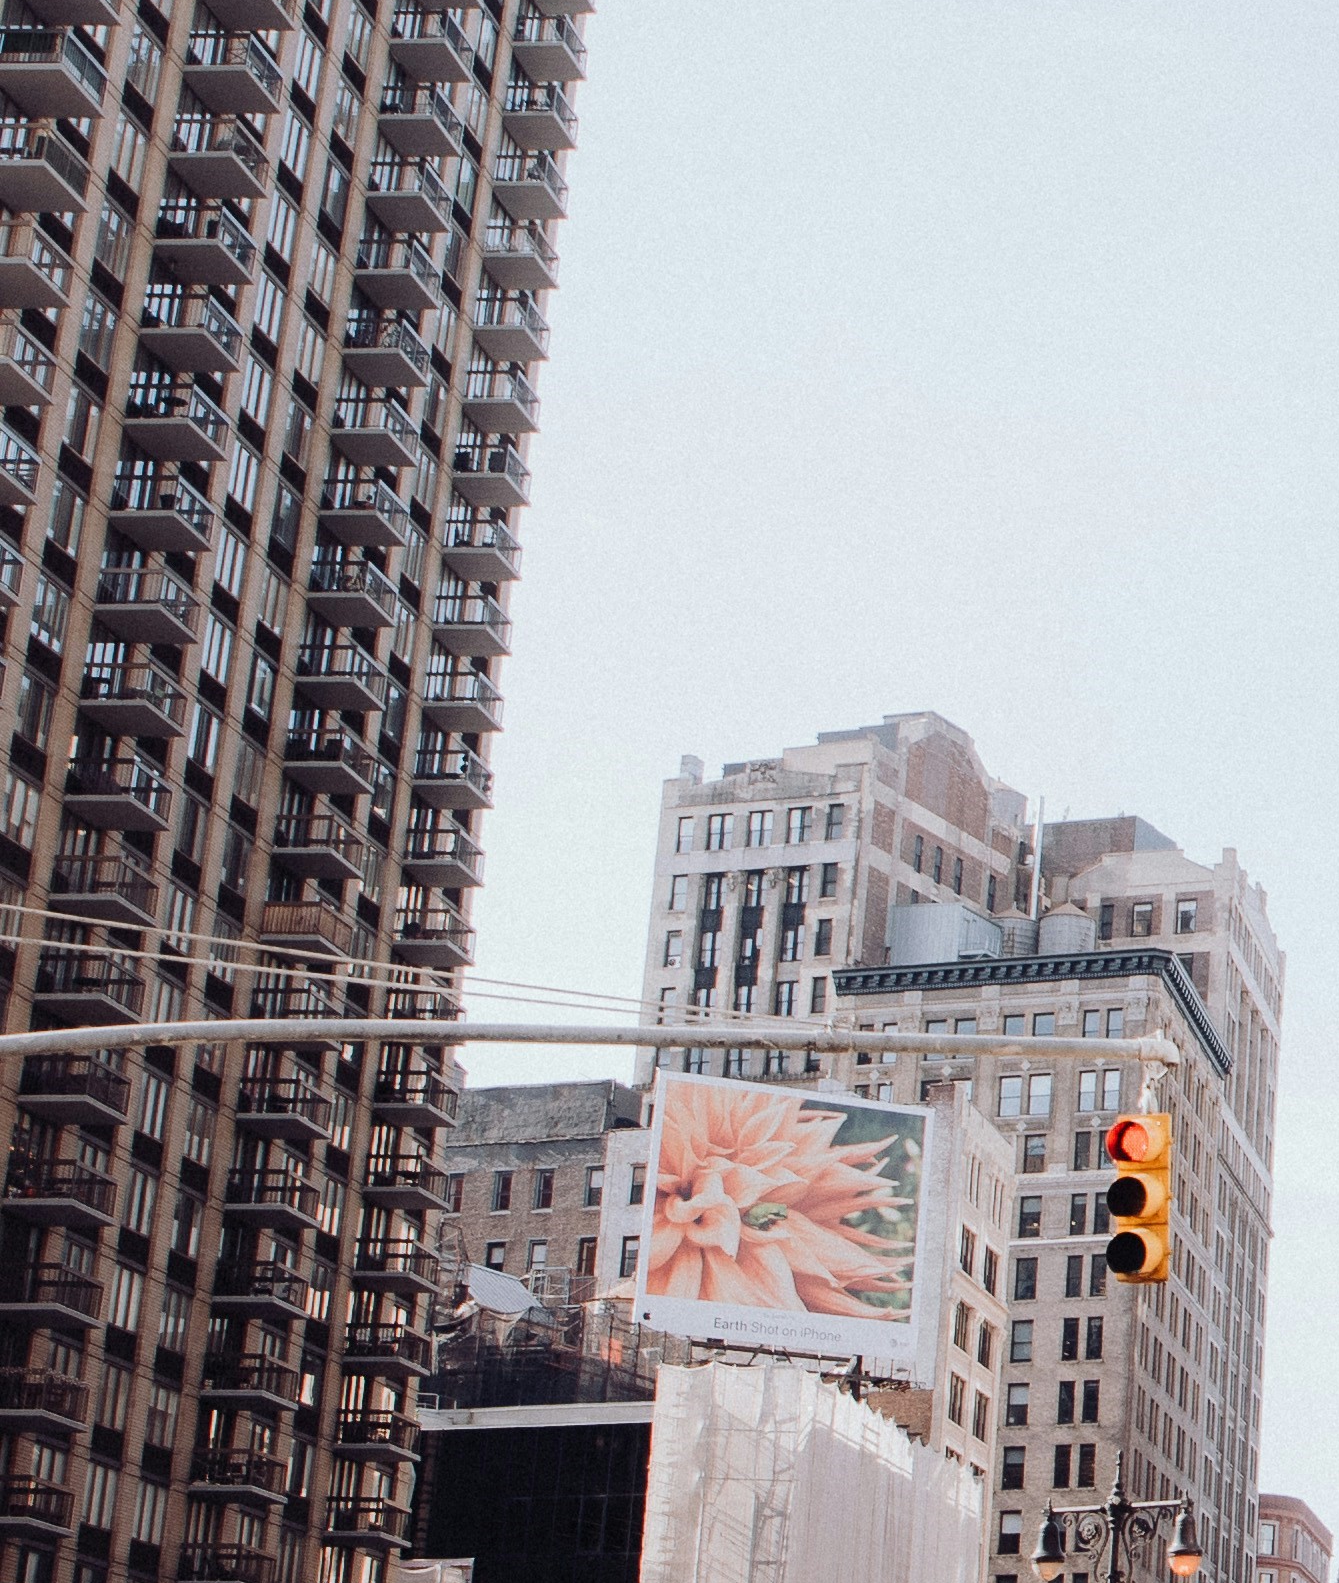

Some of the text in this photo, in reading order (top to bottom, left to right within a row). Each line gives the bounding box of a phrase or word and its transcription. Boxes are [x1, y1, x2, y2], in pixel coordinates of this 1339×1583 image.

[713, 1317, 748, 1332] Earth
[751, 1322, 779, 1335] Shot
[782, 1327, 797, 1338] on
[800, 1329, 842, 1342] iPhone
